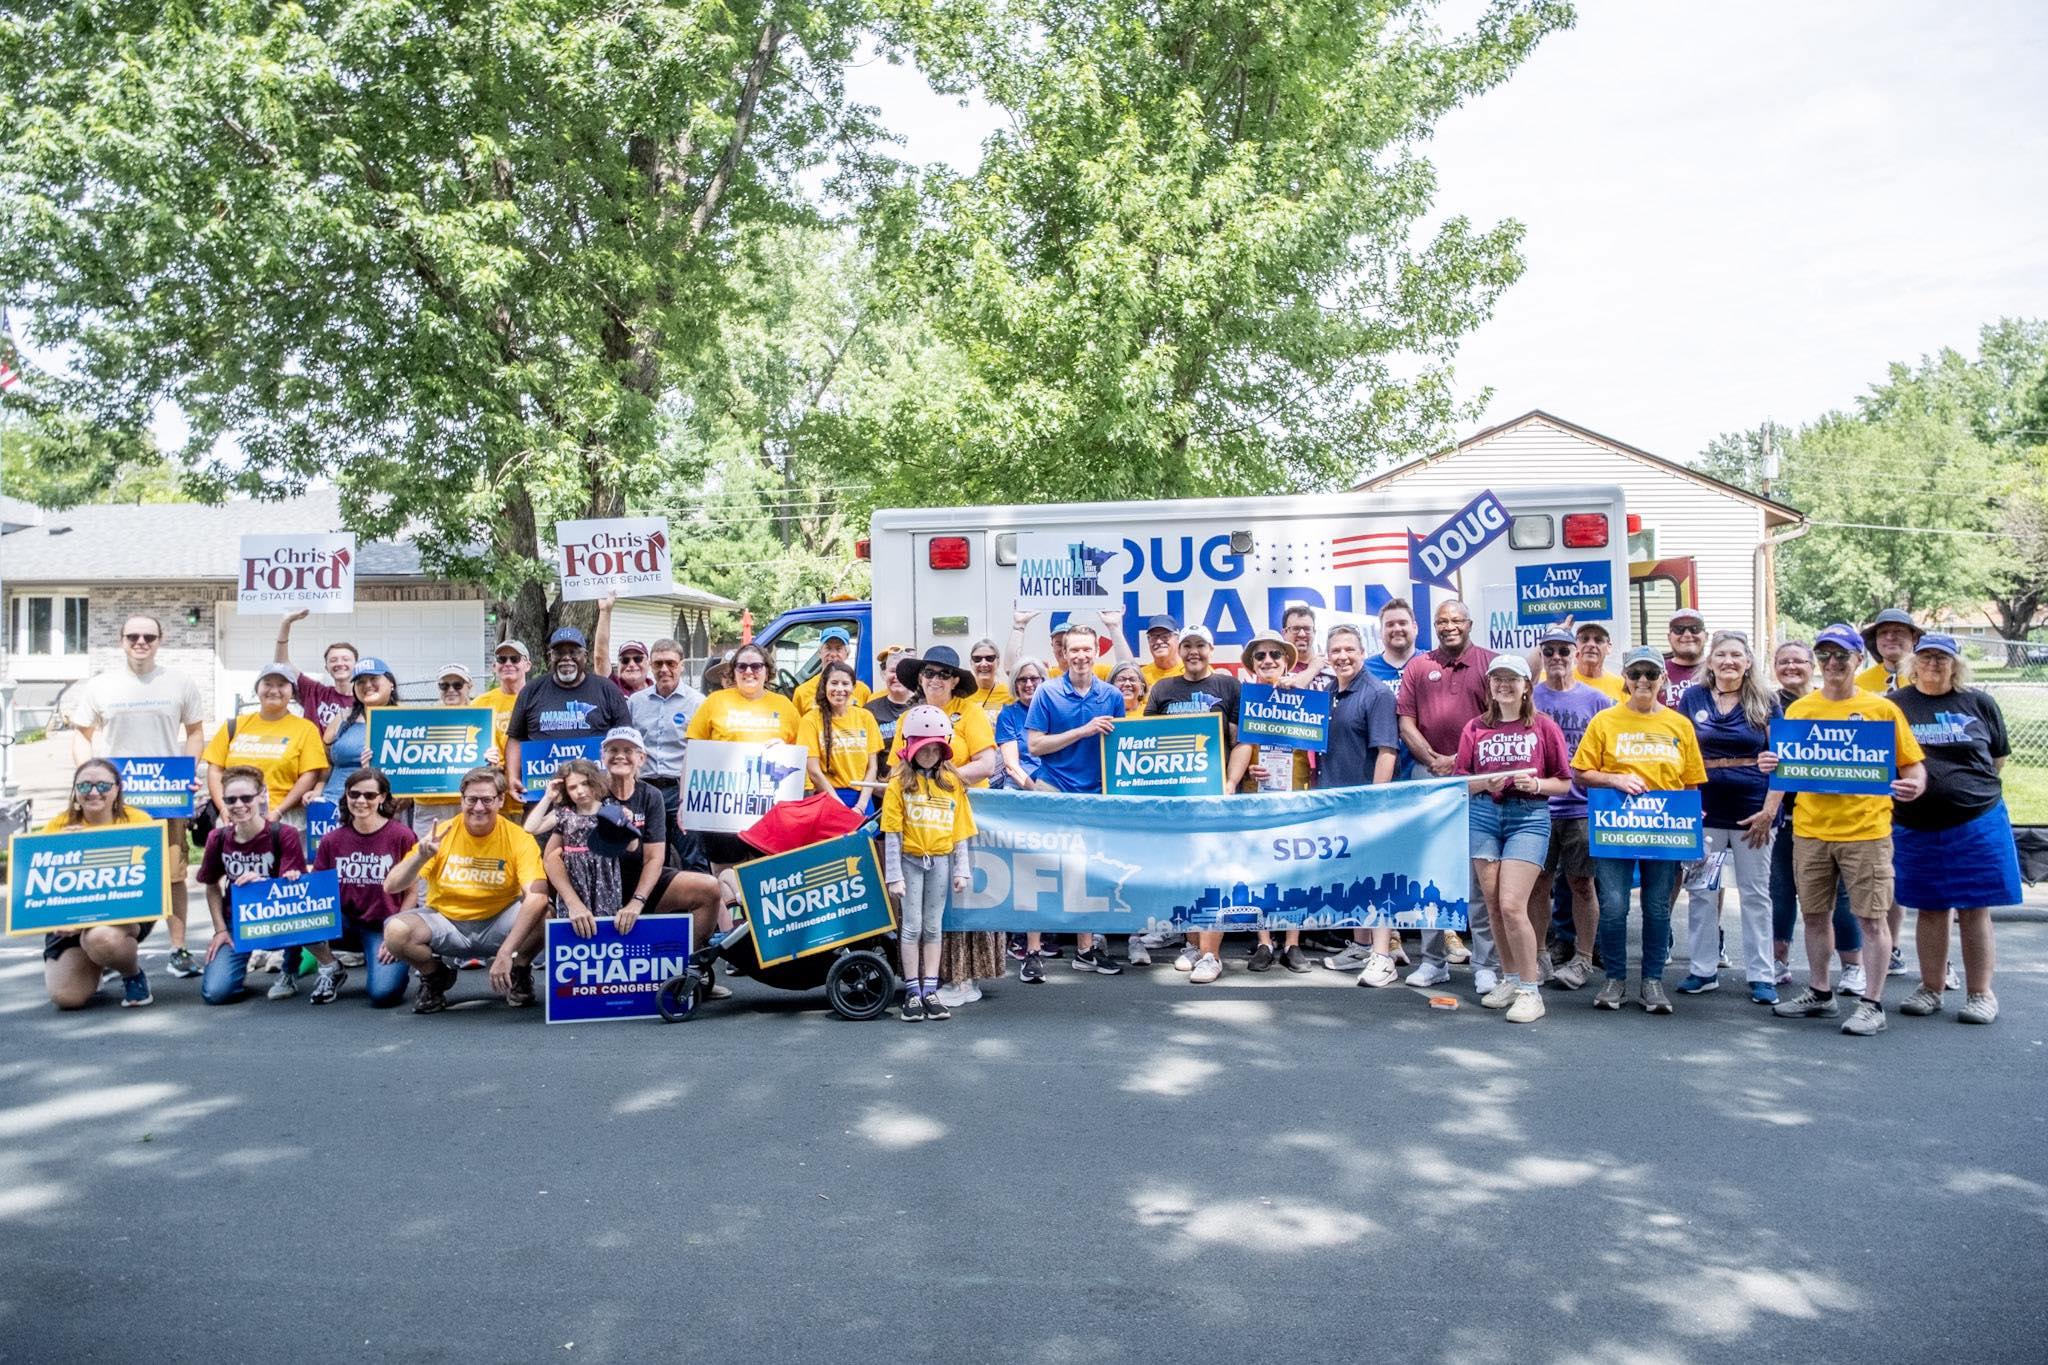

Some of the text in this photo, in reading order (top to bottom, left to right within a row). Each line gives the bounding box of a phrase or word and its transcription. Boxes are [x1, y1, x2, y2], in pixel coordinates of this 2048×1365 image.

[592, 532, 643, 549] Chris
[1418, 498, 1506, 577] DOUG
[274, 547, 327, 564] Chris
[562, 538, 661, 578] Ford
[242, 554, 342, 591] Ford
[1020, 557, 1085, 578] AMANDA
[1543, 566, 1582, 583] Amy
[564, 573, 662, 588] for STATE SENATE
[1020, 577, 1098, 596] MATCHETT
[1521, 580, 1608, 600] Klobuchar
[241, 591, 342, 601] for STATE SENATE
[1528, 599, 1601, 613] FOR GOVERNOR
[1268, 688, 1305, 709] Amy
[1244, 701, 1324, 725] Klobuchar
[385, 724, 427, 739] Matt
[1248, 722, 1318, 738] FOR GOVERNOR
[1492, 733, 1523, 743] Chris
[1806, 723, 1858, 746] Amy
[380, 739, 478, 764] NORRIS
[548, 743, 586, 760] Amy
[1118, 736, 1157, 750] Matt
[1477, 739, 1533, 761] Ford
[1776, 742, 1889, 763] Klobuchar
[121, 759, 165, 778] Amy
[397, 766, 446, 776] Minnesota
[1115, 751, 1209, 775] NORRIS
[1783, 765, 1881, 780] FOR GOVERNOR
[120, 775, 190, 792] obuchar
[1116, 779, 1132, 787] For
[1132, 777, 1179, 787] Minnesota
[124, 794, 182, 806] GOVERNOR
[686, 790, 774, 816] MATCHETT
[1621, 793, 1668, 814] Amy
[1594, 810, 1697, 829] Klobuchar
[970, 831, 1087, 850] INNESOTA
[1273, 835, 1351, 861] SD32
[1601, 833, 1690, 845] FOR GOVERNOR
[31, 850, 82, 868] Matt
[232, 850, 260, 862] Chris
[350, 851, 379, 863] Chris
[335, 856, 385, 880] Ford
[440, 863, 506, 885] NORRIS
[25, 864, 146, 897] NORRIS
[760, 871, 804, 897] Matt
[951, 849, 1110, 913] DFL
[25, 889, 144, 909] For Minnesota House
[267, 882, 310, 900] Amy
[761, 875, 866, 925] NORRIS
[238, 895, 336, 922] Klobuchar
[247, 915, 330, 937] FOR GOVERNOR
[767, 902, 869, 938] For Minnesota House
[555, 942, 625, 962] DOUG
[555, 956, 684, 984] CHAPIN
[572, 987, 598, 996] FOR
